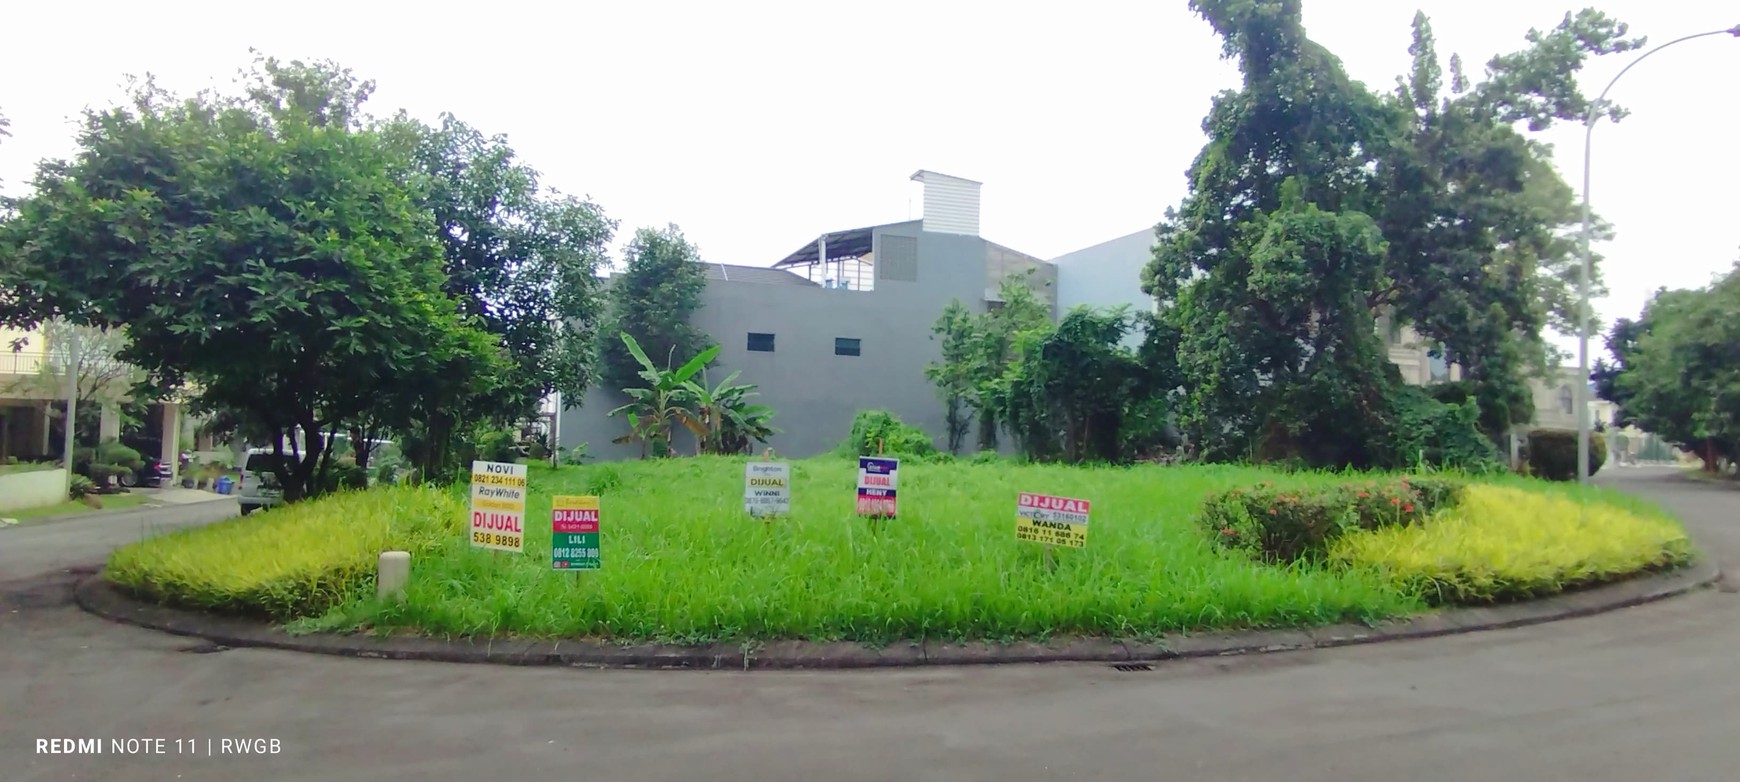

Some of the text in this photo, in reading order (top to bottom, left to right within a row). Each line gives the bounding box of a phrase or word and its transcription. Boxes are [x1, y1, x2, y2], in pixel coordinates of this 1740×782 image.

[487, 464, 514, 475] NOVI
[474, 474, 490, 483] 0821
[491, 476, 503, 484] 234
[504, 477, 516, 486] 111
[750, 478, 784, 486] DIJUAL
[479, 486, 520, 499] RayWhite
[1020, 494, 1087, 513] DIJUAL
[474, 511, 522, 533] DIJUAL
[554, 510, 598, 522] DIJUAL
[1032, 519, 1071, 531] WANDA
[473, 532, 520, 548] 538 9898
[568, 535, 586, 544] LILI
[1042, 528, 1052, 536] 11
[1073, 532, 1085, 541] 74
